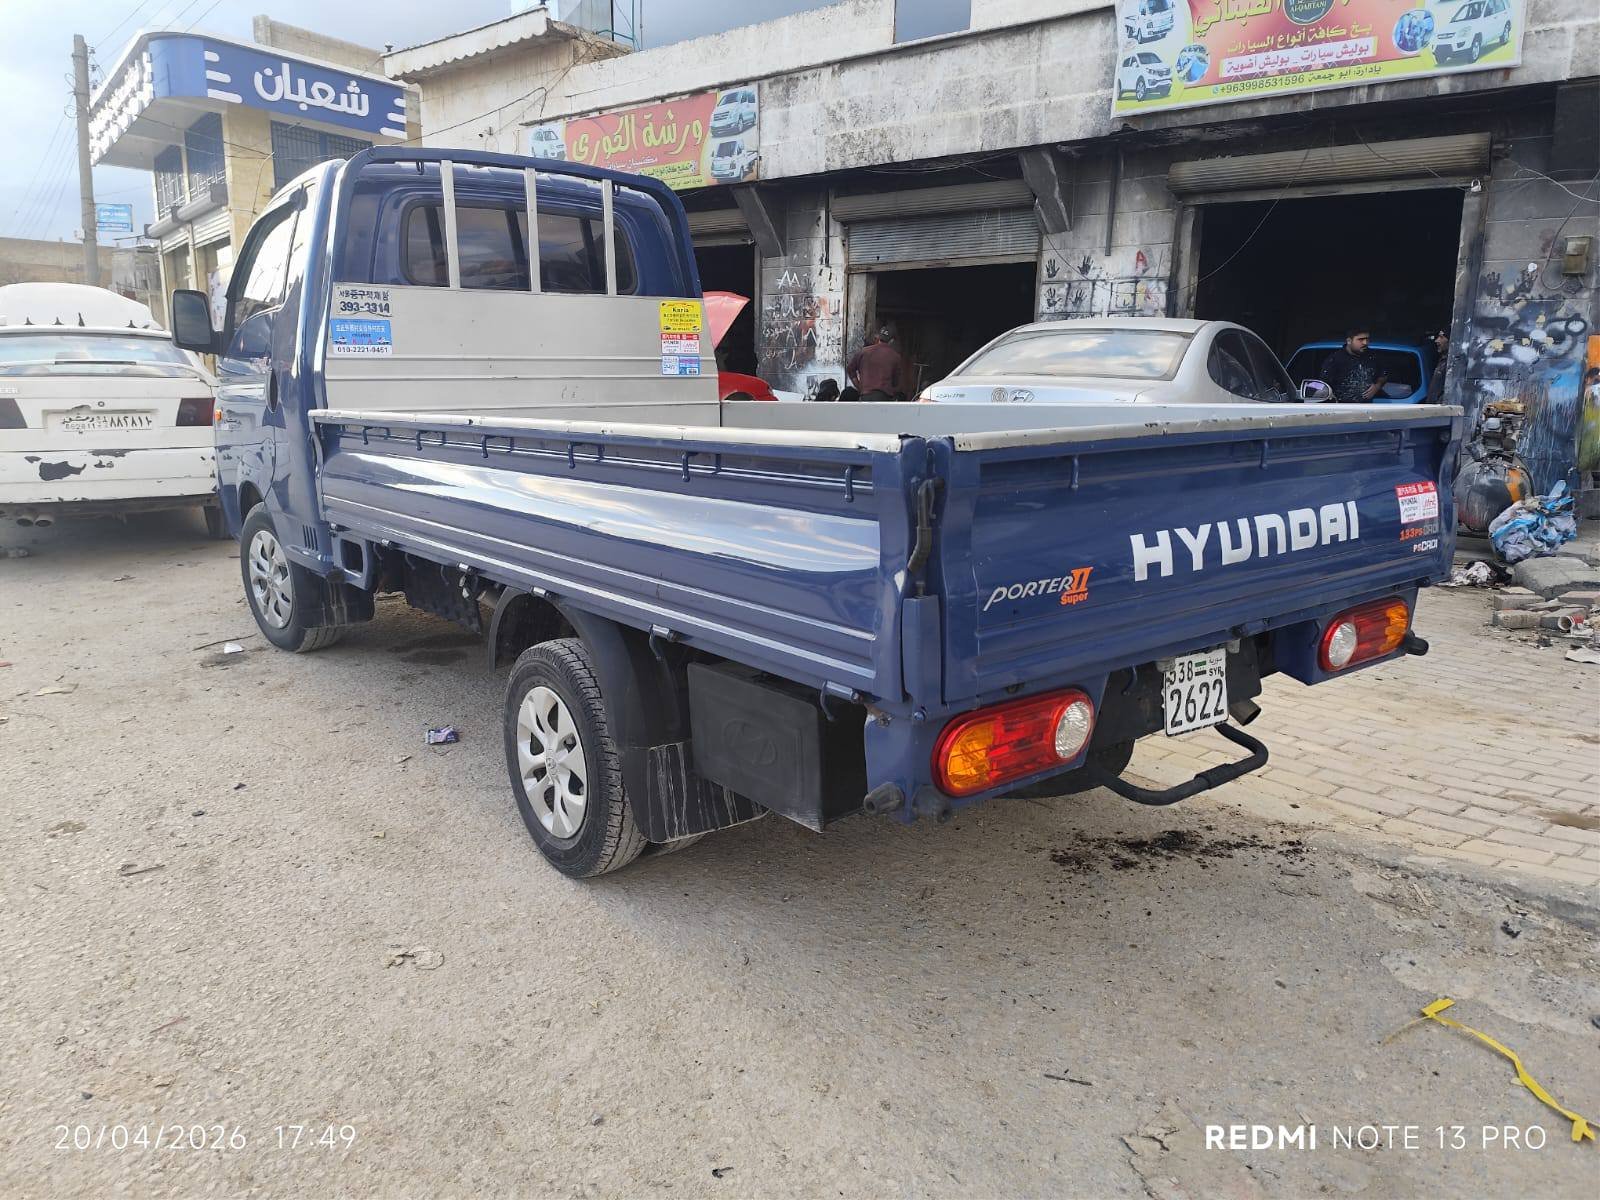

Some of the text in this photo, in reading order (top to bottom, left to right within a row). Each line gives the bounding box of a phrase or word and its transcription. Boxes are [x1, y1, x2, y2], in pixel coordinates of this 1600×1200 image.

[1277, 27, 1306, 48] أنواع
[1308, 25, 1347, 42] كافة
[1227, 35, 1274, 53] السيارات
[1336, 43, 1369, 58] بوليش
[1259, 55, 1290, 69] بوليش
[1301, 49, 1334, 61] سيارات
[254, 62, 369, 117] شعبان
[641, 109, 704, 155] ورشة
[1130, 501, 1359, 582] HYUNDAI
[983, 575, 1074, 611] PORTER
[1060, 592, 1089, 606] Super
[1170, 679, 1225, 729] 2622
